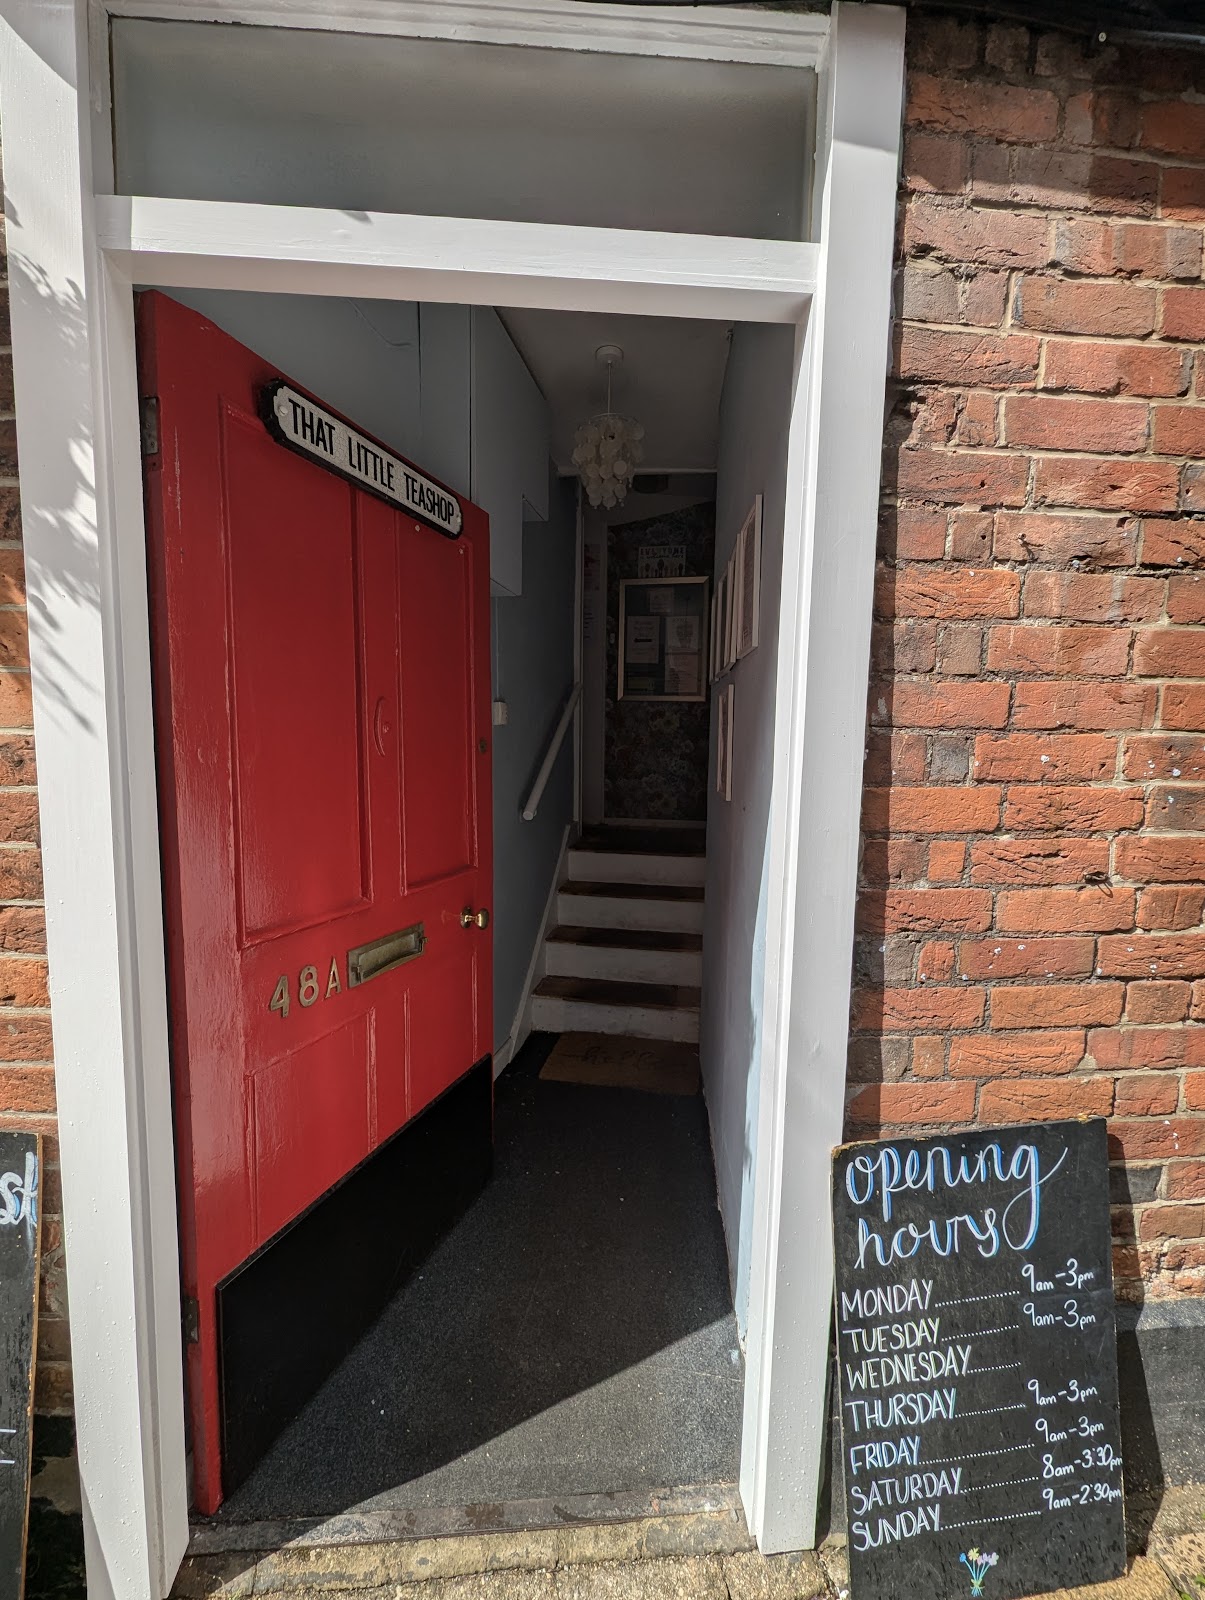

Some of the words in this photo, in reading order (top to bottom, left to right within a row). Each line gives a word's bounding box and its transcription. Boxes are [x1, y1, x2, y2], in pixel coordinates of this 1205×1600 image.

[288, 397, 336, 456] THAT
[348, 436, 395, 492] LITTLE
[403, 471, 455, 525] TEASHOP
[270, 956, 342, 1018] 48A
[846, 1143, 1068, 1251] opening
[854, 1208, 1000, 1269] hours
[841, 1278, 933, 1322] MONDAY
[842, 1317, 940, 1354] TUESDAY
[845, 1344, 972, 1392] WEDNESDAY
[844, 1387, 957, 1432] THURSDAY
[850, 1435, 921, 1475] FRIDAY
[851, 1467, 963, 1516] SATURDAY
[852, 1503, 941, 1552] SUNDAY
